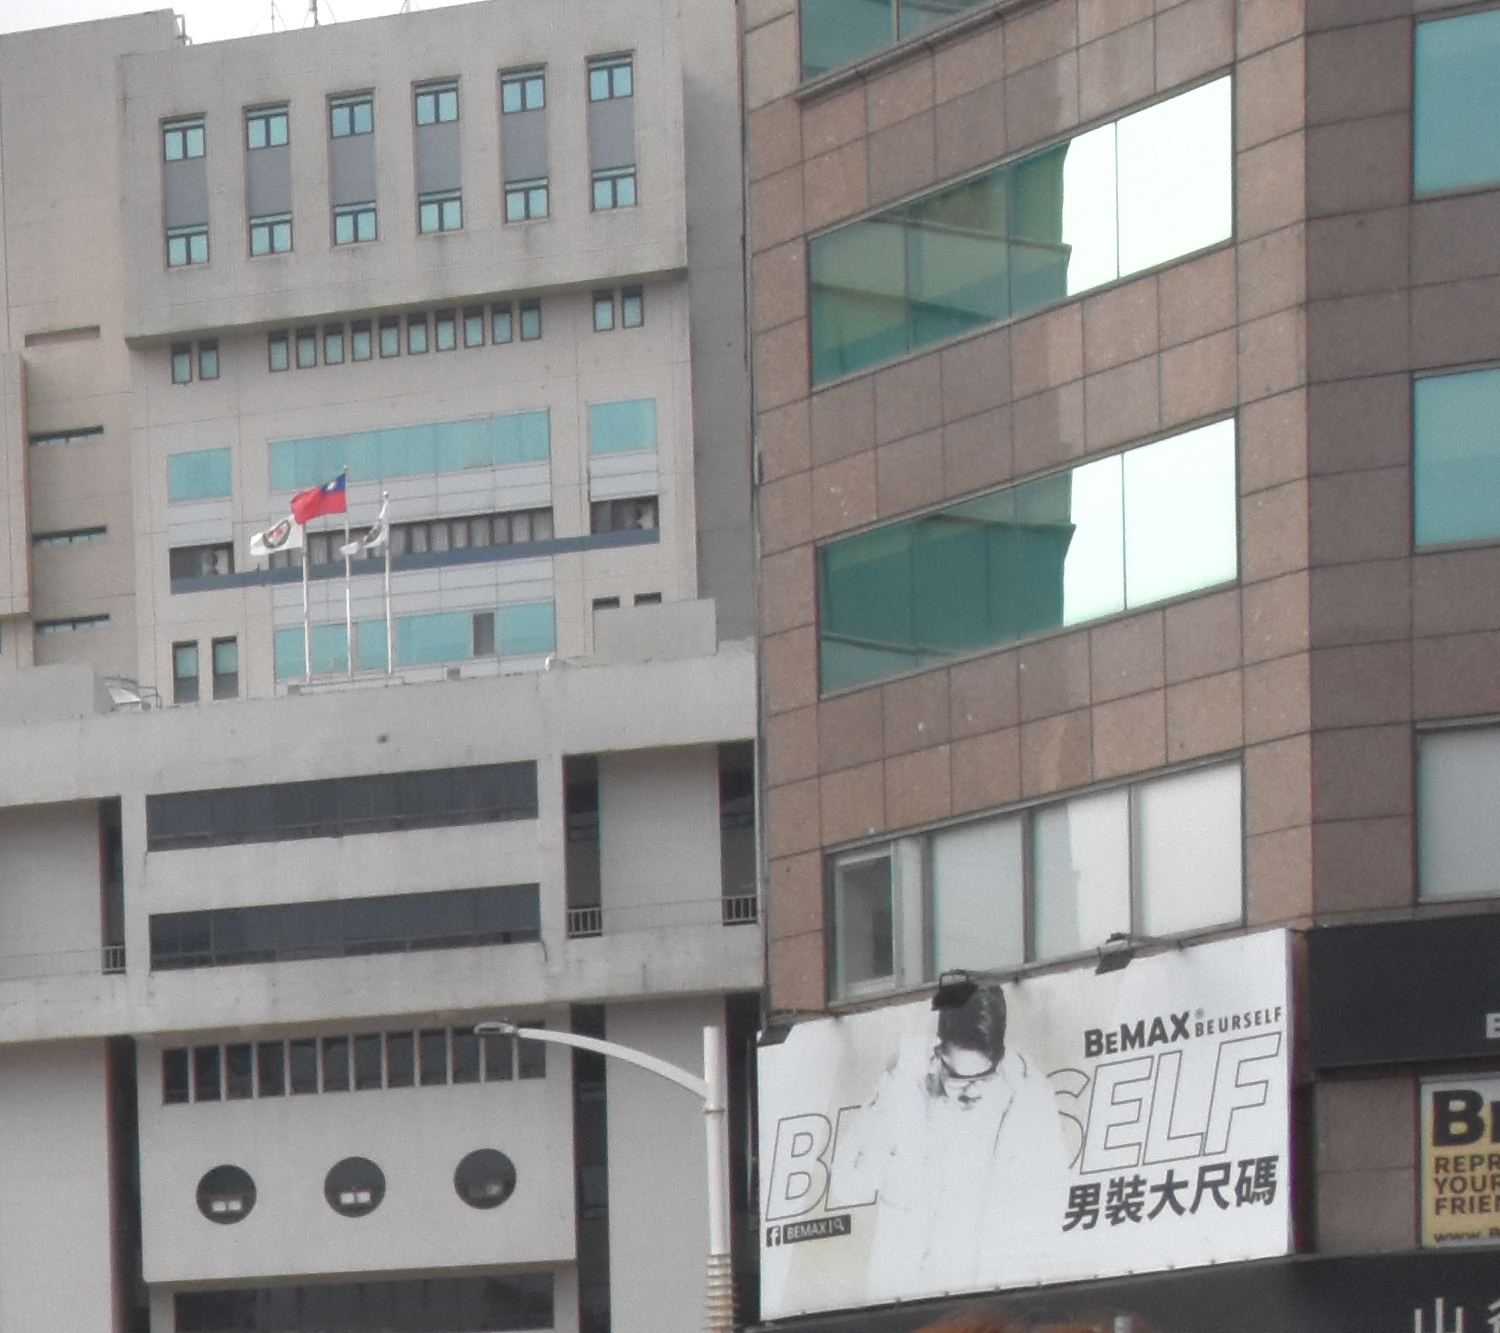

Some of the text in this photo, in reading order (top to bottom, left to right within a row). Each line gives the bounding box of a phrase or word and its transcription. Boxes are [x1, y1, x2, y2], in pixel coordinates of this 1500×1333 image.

[1193, 1005, 1283, 1039] BEURSELF
[1062, 1154, 1280, 1233] 男裝大尺碼
